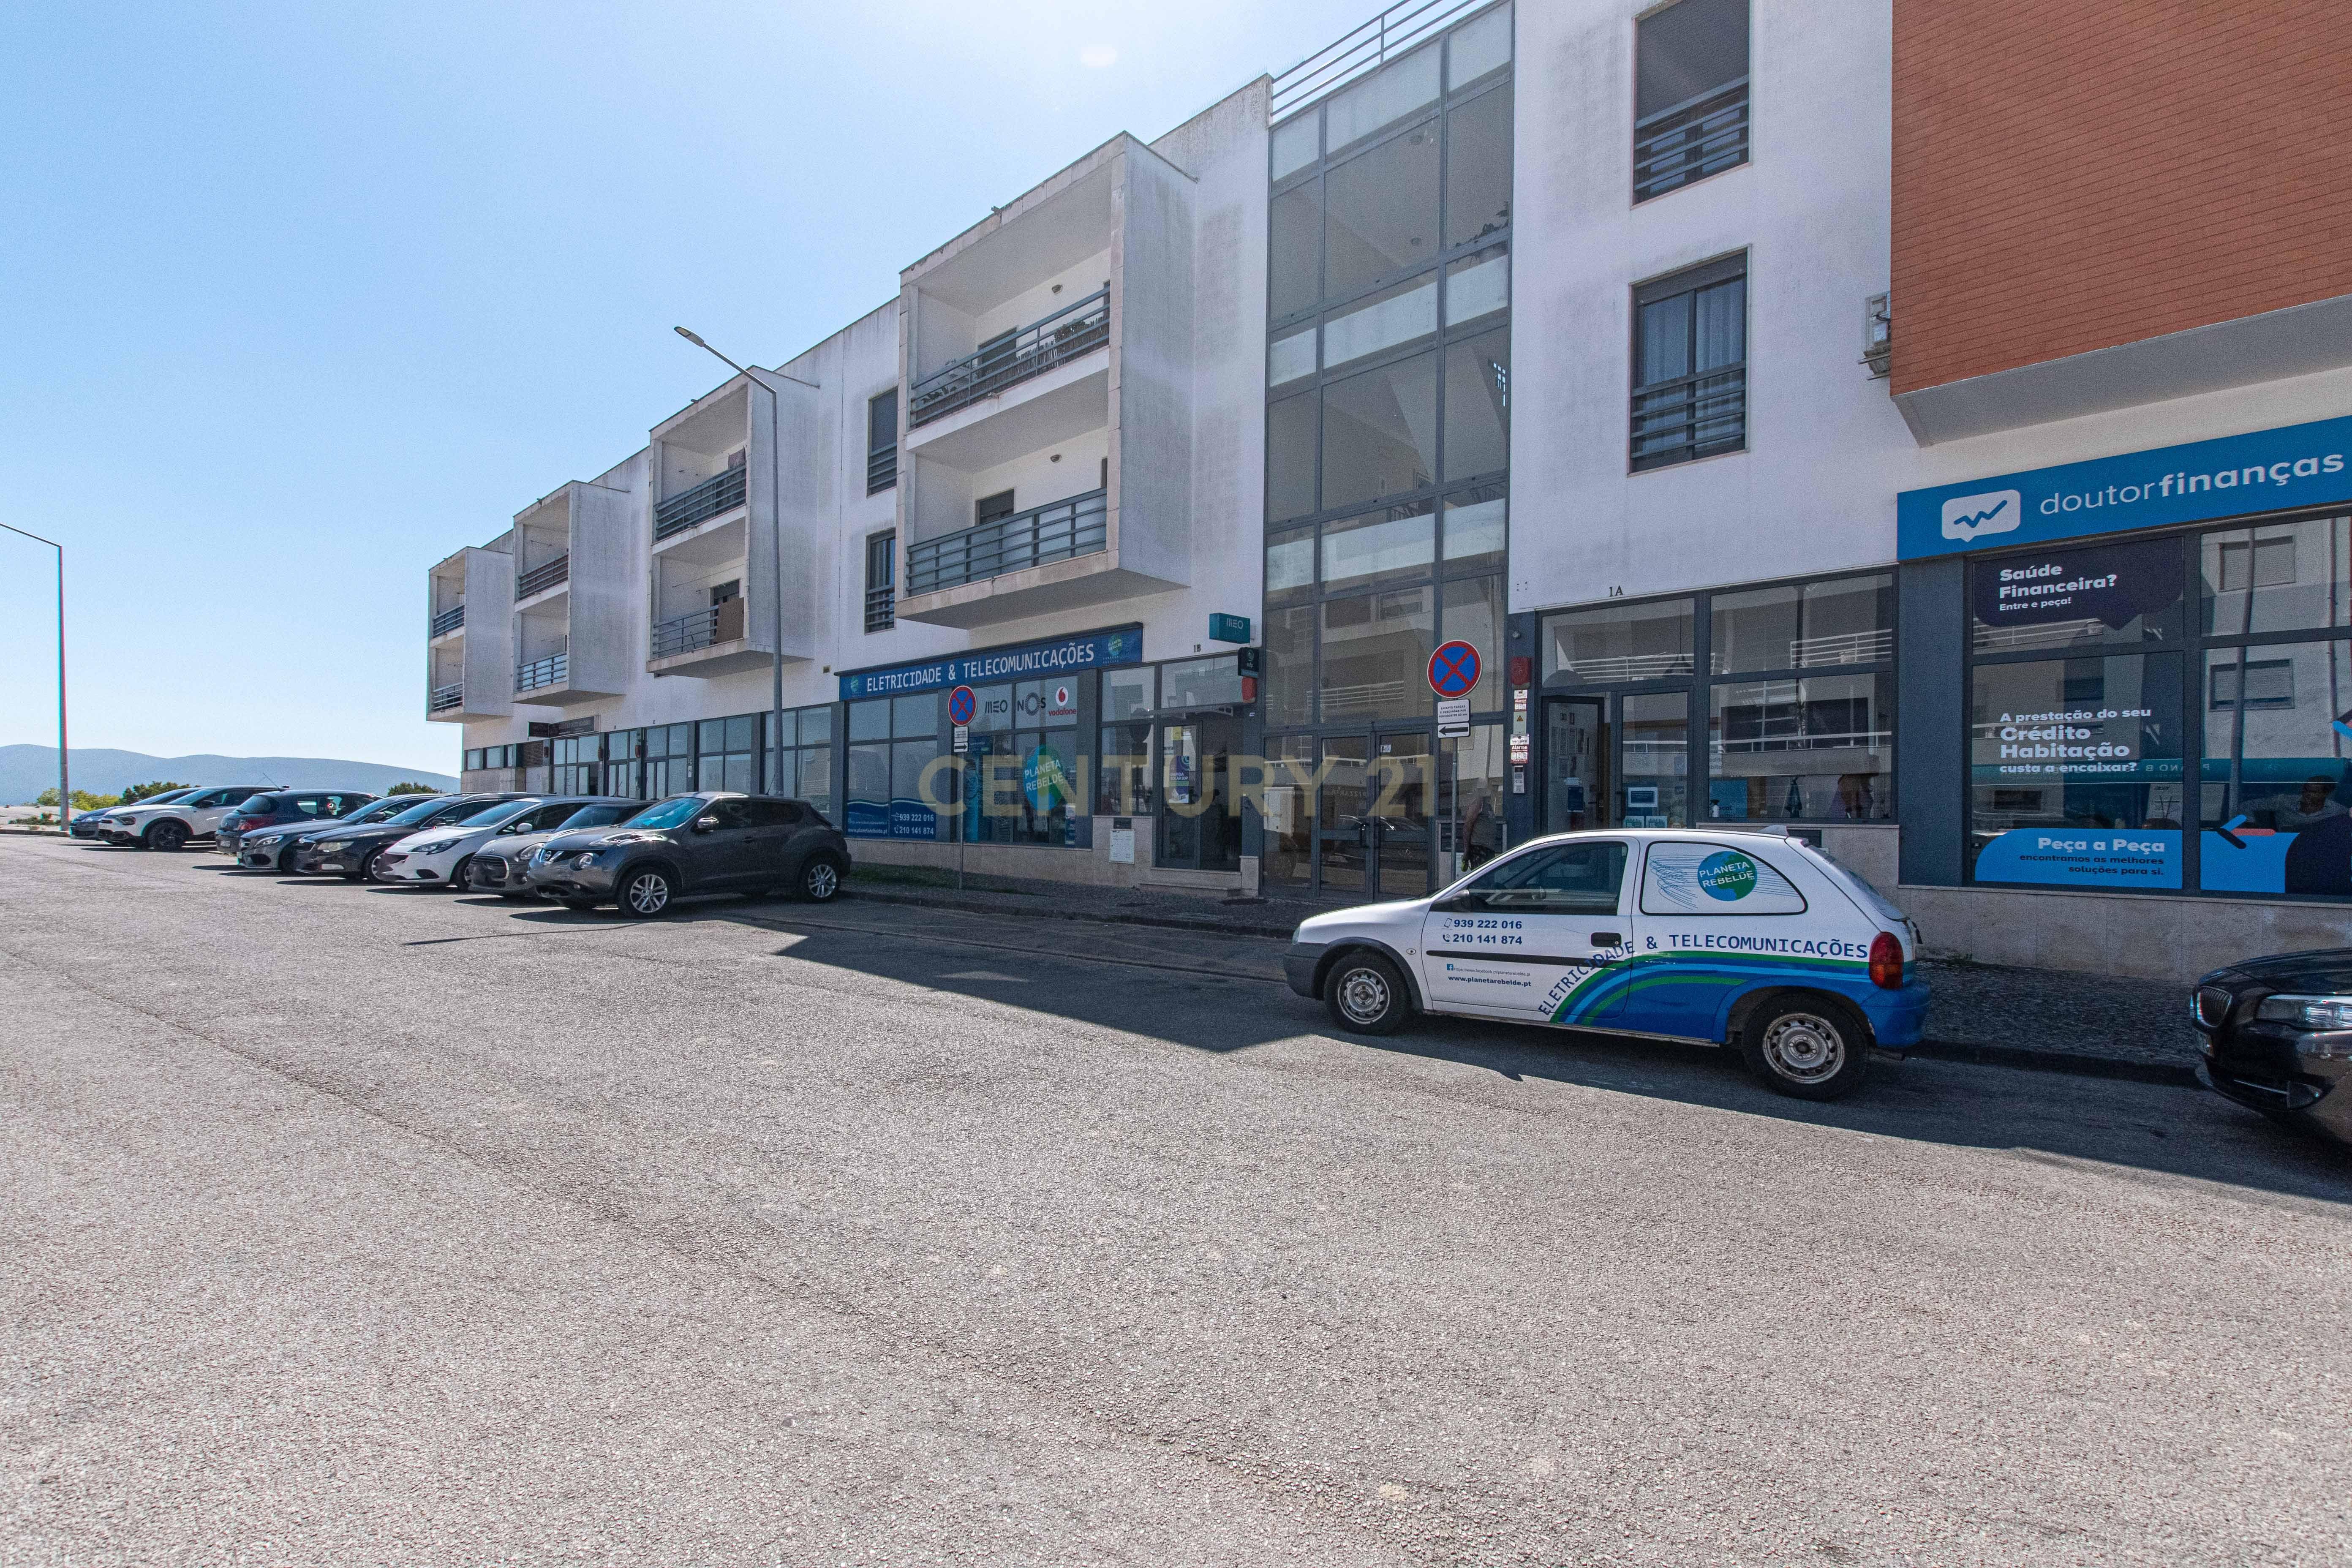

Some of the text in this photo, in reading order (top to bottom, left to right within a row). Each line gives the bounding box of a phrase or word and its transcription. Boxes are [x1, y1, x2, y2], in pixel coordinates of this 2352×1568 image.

[2040, 454, 2344, 515] doutorfinanças
[1999, 564, 2063, 581] Saúde
[1609, 585, 1623, 597] 1A
[1999, 574, 2118, 599] Financeira?
[2041, 597, 2072, 608] peça!
[1227, 618, 1244, 629] MEO
[1194, 644, 1201, 653] 1B
[867, 642, 1094, 692] ELETRICIDADE & TELECOMUNICAÇÕES
[985, 700, 1008, 713] MEO
[1017, 692, 1046, 716] NOS
[1048, 707, 1077, 716] vodafone
[2000, 708, 2151, 724] A prestação do seu
[2000, 725, 2091, 741] Crédito
[2001, 742, 2131, 761] Habitação
[1024, 759, 1061, 779] PLANETA
[1999, 764, 2041, 772] custa
[2059, 762, 2138, 773] encaixar?
[1026, 772, 1063, 792] REBELDE
[2038, 838, 2165, 855] Peça a Peça
[2020, 855, 2090, 863] encontramos
[2110, 857, 2164, 865] melhores
[1699, 861, 1750, 878] PLANETA
[2068, 865, 2117, 874] soluções
[1702, 870, 1754, 887] REBELDE
[1454, 919, 1522, 929] 939 222 016
[1453, 934, 1522, 945] 210 141 874
[1448, 975, 1532, 988] www.planetarebelde.pt
[1538, 934, 1868, 1016] ELETRICIDADE & TELECOMUNICAÇÕES
